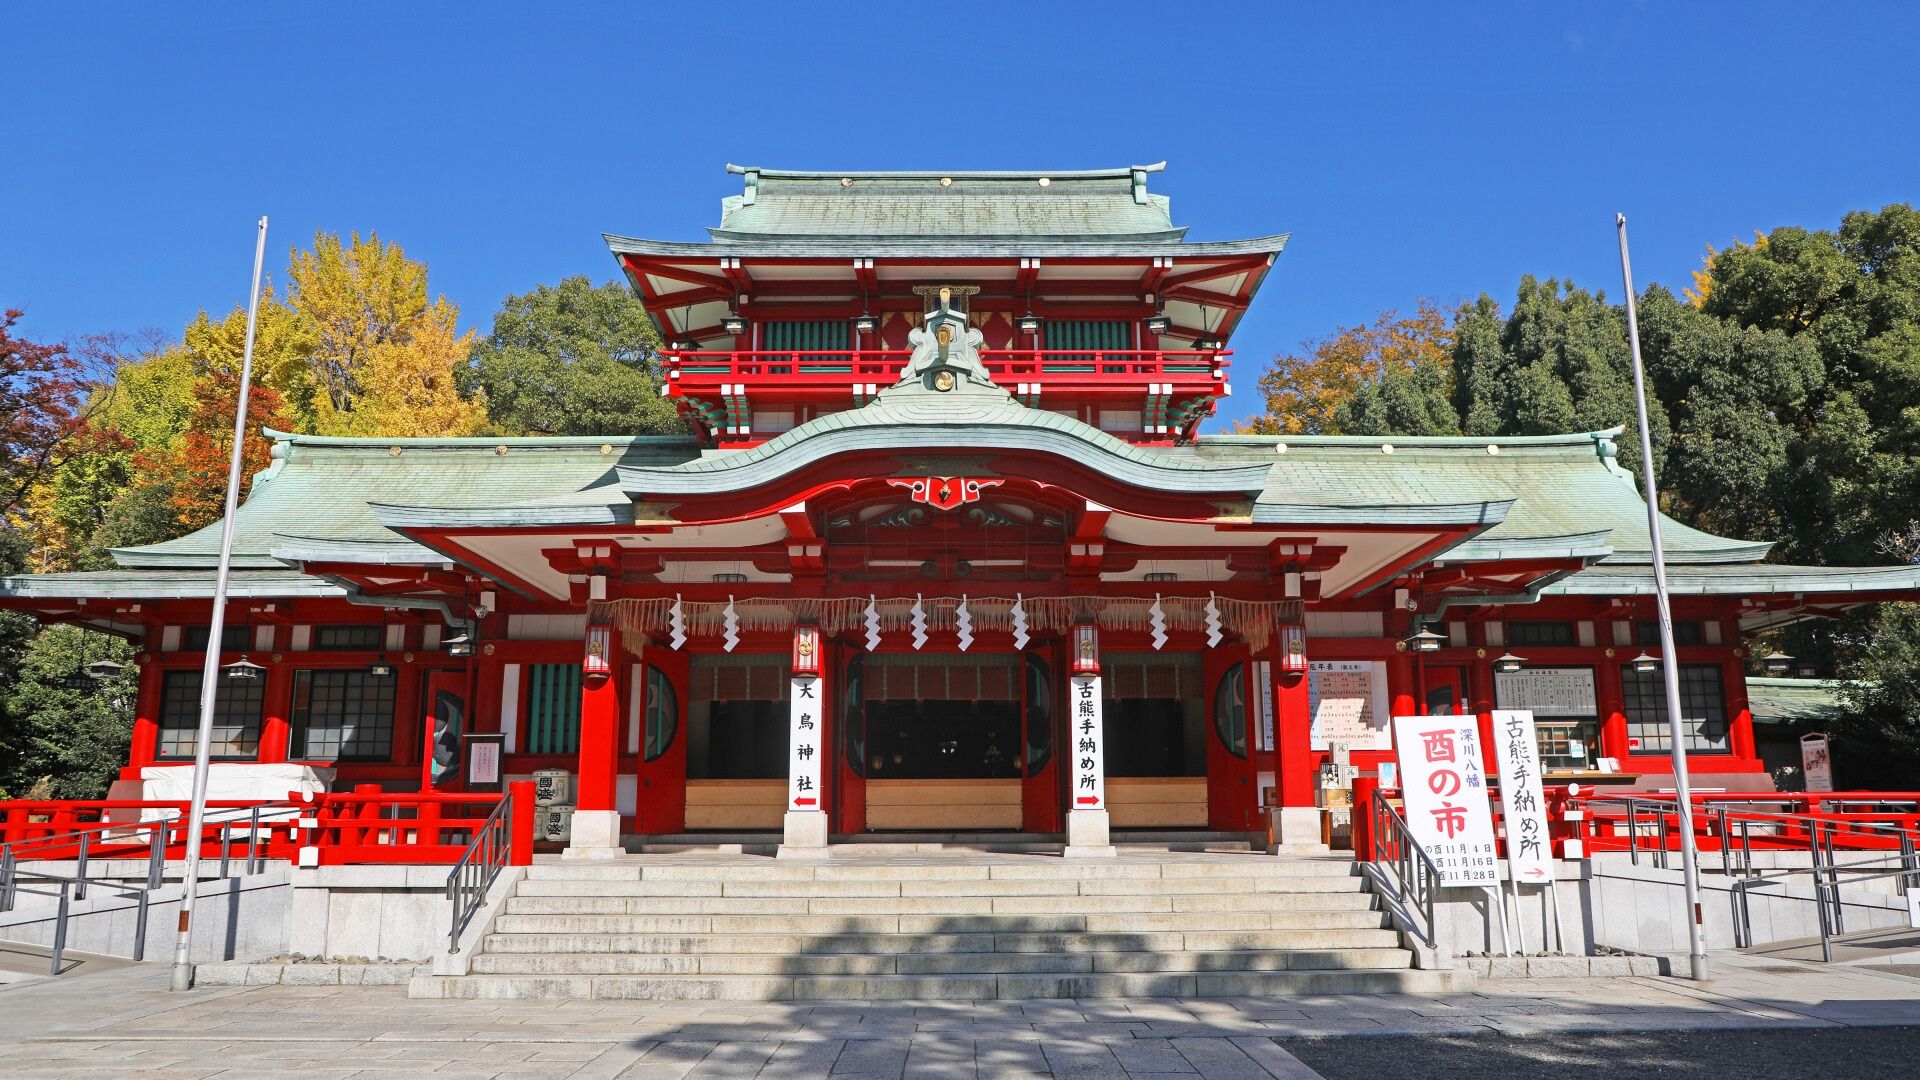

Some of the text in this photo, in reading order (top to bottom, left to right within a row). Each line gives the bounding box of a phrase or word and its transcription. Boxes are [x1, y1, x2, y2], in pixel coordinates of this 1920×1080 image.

[797, 683, 815, 792] 大鳥神社
[1078, 682, 1096, 790] 古熊手納め所
[1418, 728, 1468, 839] 酉の市
[1460, 728, 1480, 788] 深川八幡
[1506, 715, 1541, 861] 古熊手納め所
[1424, 843, 1491, 855] の酉11月4日
